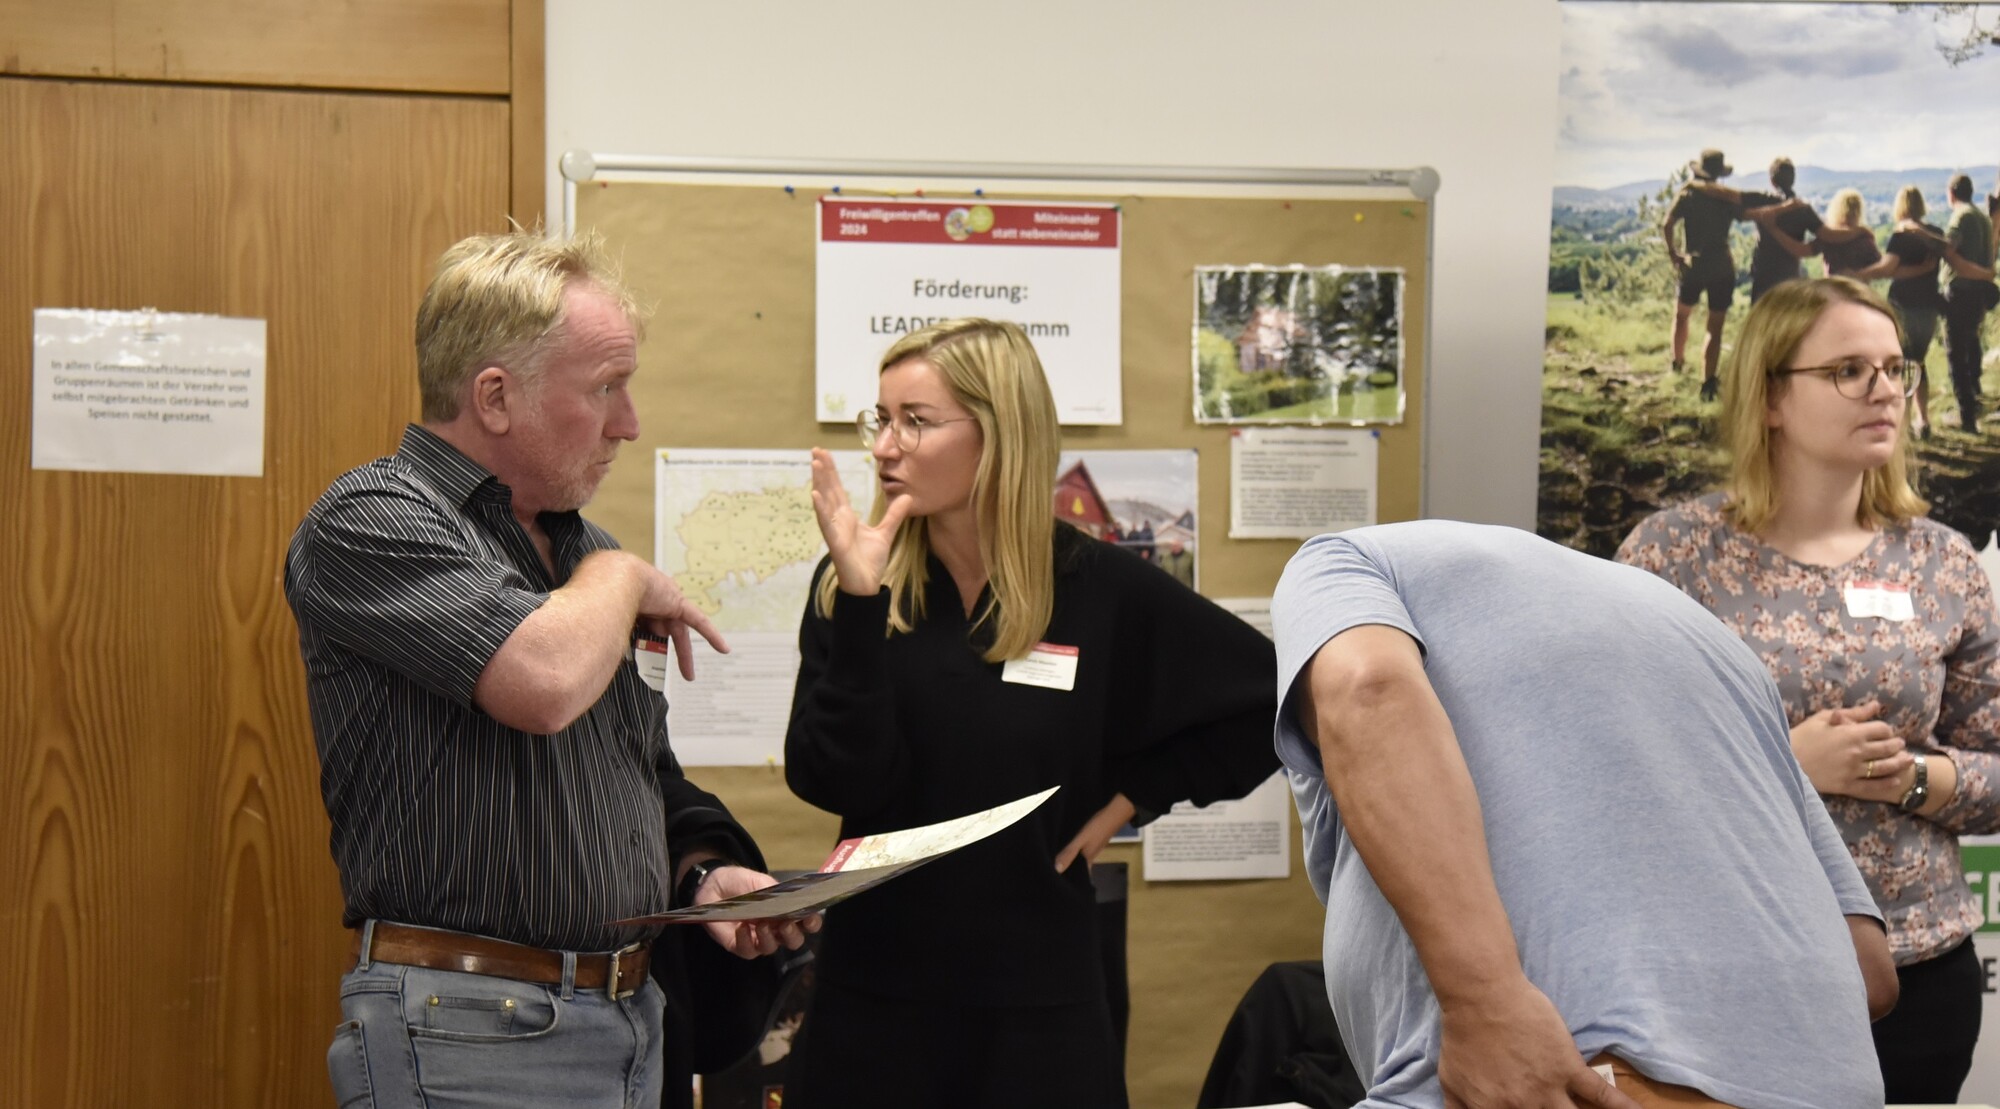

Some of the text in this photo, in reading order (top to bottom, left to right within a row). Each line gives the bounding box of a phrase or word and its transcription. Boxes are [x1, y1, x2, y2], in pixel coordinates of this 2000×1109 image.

[840, 207, 941, 223] Freiwilligentreffen
[1033, 212, 1100, 225] Miteinander
[840, 223, 868, 235] 2024
[992, 228, 1100, 241] statt nebeneinander
[914, 280, 1029, 303] Förderung:
[51, 360, 251, 378] In allen Gemeinschaftsbereichen und
[54, 376, 248, 393] Gruppenräumen ist der Verzehr von
[52, 391, 250, 409] selbst mitgebrachten Getränken und
[88, 408, 214, 423] Speisen nicht gestattet.
